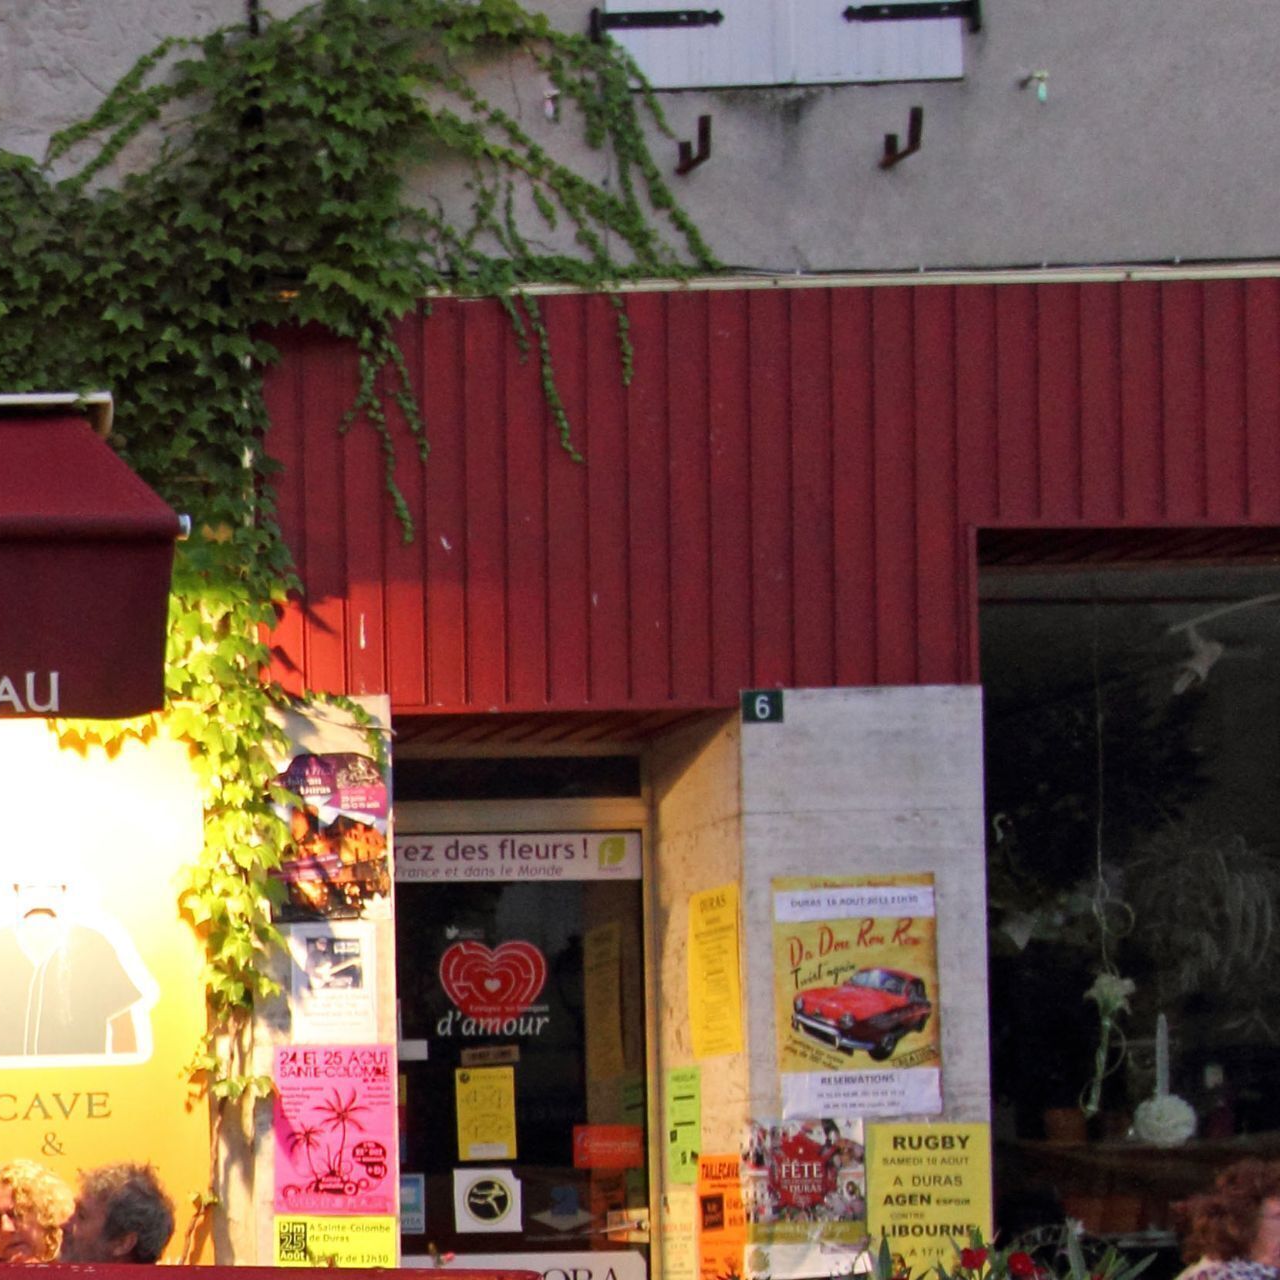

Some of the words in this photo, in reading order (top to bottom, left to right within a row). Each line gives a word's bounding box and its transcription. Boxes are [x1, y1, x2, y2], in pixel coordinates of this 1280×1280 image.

[755, 694, 770, 719] 6
[444, 839, 490, 861] des
[498, 836, 575, 861] fleurs
[444, 866, 459, 878] et
[463, 865, 496, 878] dans
[500, 865, 513, 877] le
[517, 864, 563, 877] Monde
[279, 1051, 298, 1066] 24
[40, 1131, 68, 1157] &
[892, 1135, 971, 1151] RUGBY
[781, 1158, 823, 1179] FÊTE
[881, 1156, 923, 1166] SAMEDI
[911, 1174, 963, 1188] DURAS
[883, 1193, 932, 1206] AGEN
